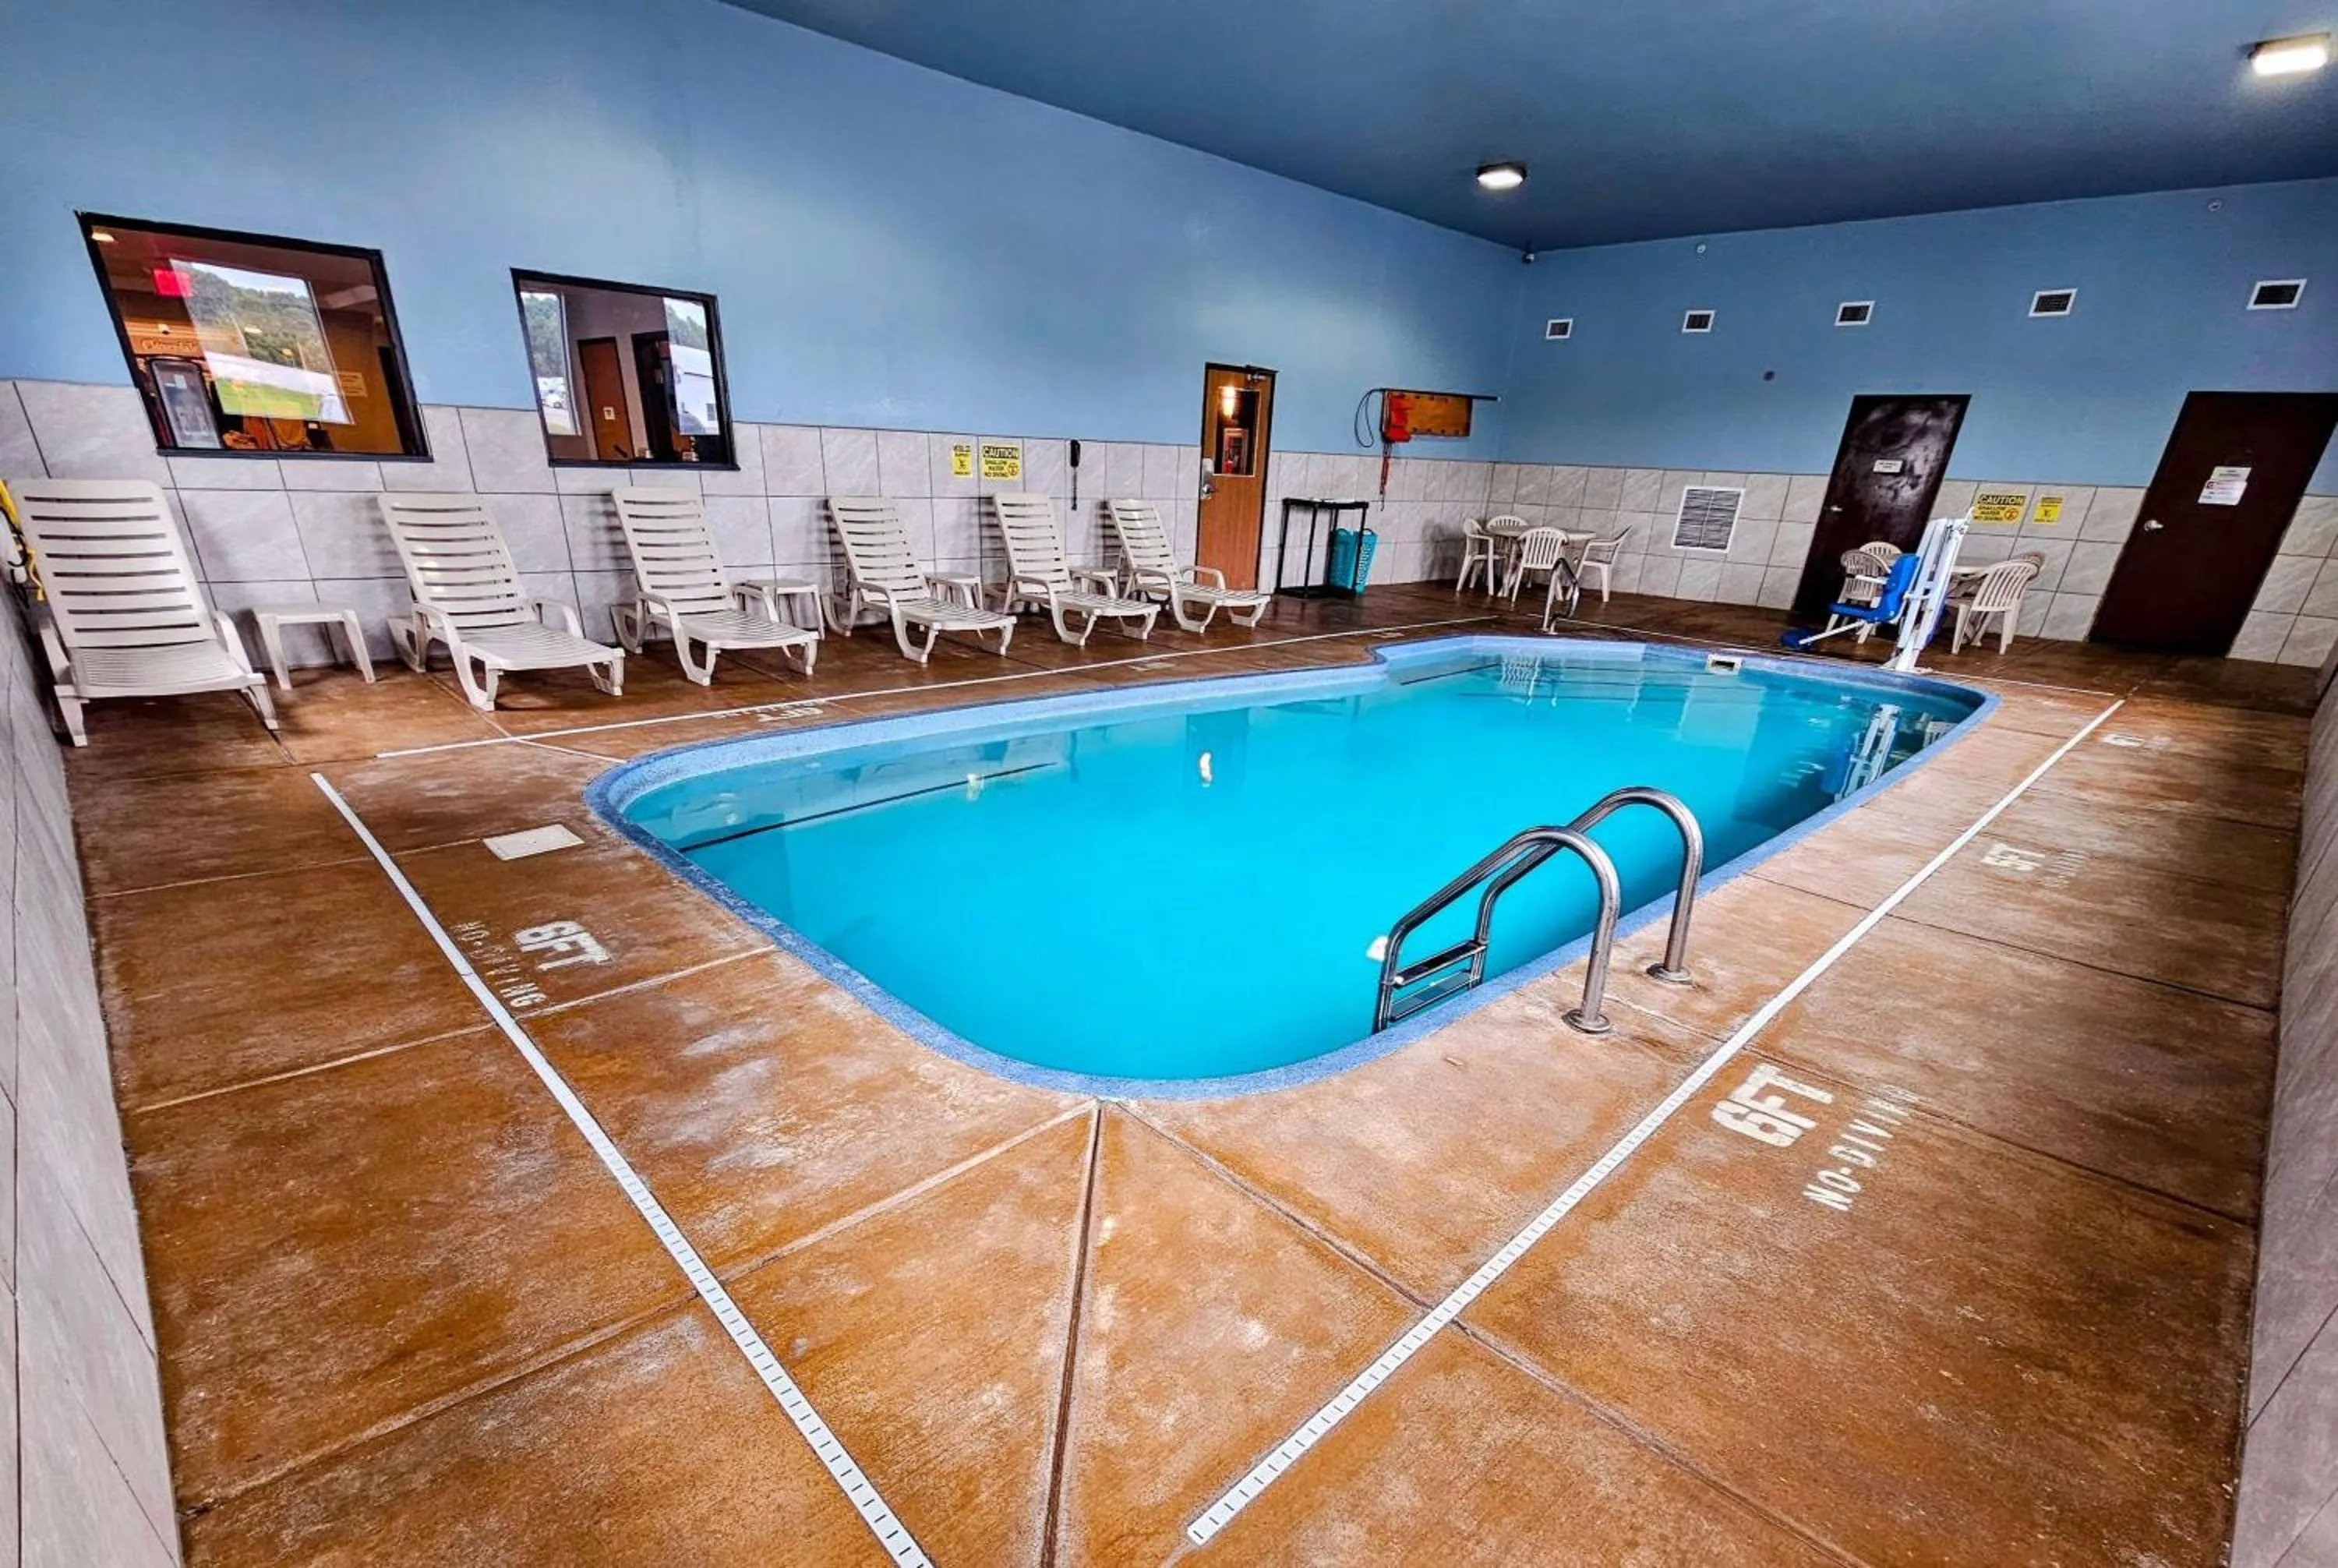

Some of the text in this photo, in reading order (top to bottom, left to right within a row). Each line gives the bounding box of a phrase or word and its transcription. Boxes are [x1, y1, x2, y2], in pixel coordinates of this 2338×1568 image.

[1980, 495, 2025, 505] CAUTION
[514, 920, 611, 972] 6FT
[1711, 1062, 1835, 1148] 6FT
